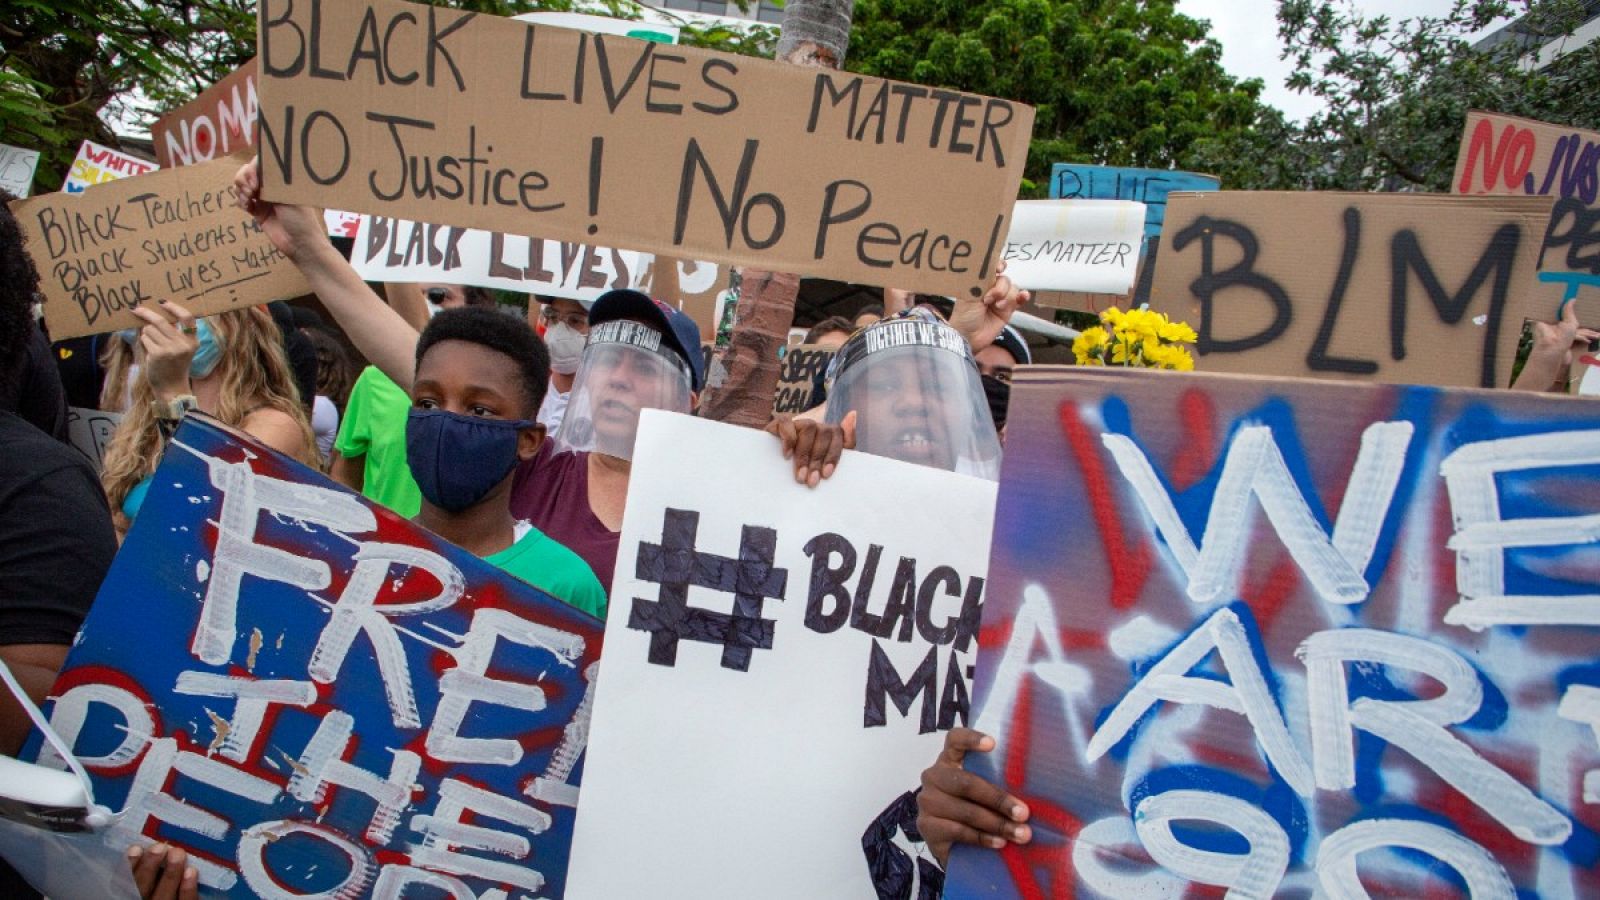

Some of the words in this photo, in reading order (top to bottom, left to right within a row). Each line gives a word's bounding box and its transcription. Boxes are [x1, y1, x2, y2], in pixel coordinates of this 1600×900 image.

[260, 0, 477, 92] BLACK
[521, 25, 739, 115] LIVES
[806, 73, 1014, 168] MATTER
[165, 115, 216, 169] NO
[37, 204, 136, 260] BLACK
[258, 106, 350, 186] NO
[673, 137, 786, 249] No
[814, 179, 1004, 297] Peace!
[53, 249, 133, 292] Black
[142, 225, 237, 265] Students
[364, 213, 467, 271] BLACK
[72, 280, 153, 326] Black
[166, 260, 222, 293] Lives
[1172, 206, 1522, 390] BLM
[865, 322, 917, 354] TOGETHER
[918, 322, 937, 346] WE
[1102, 420, 1600, 632] WE
